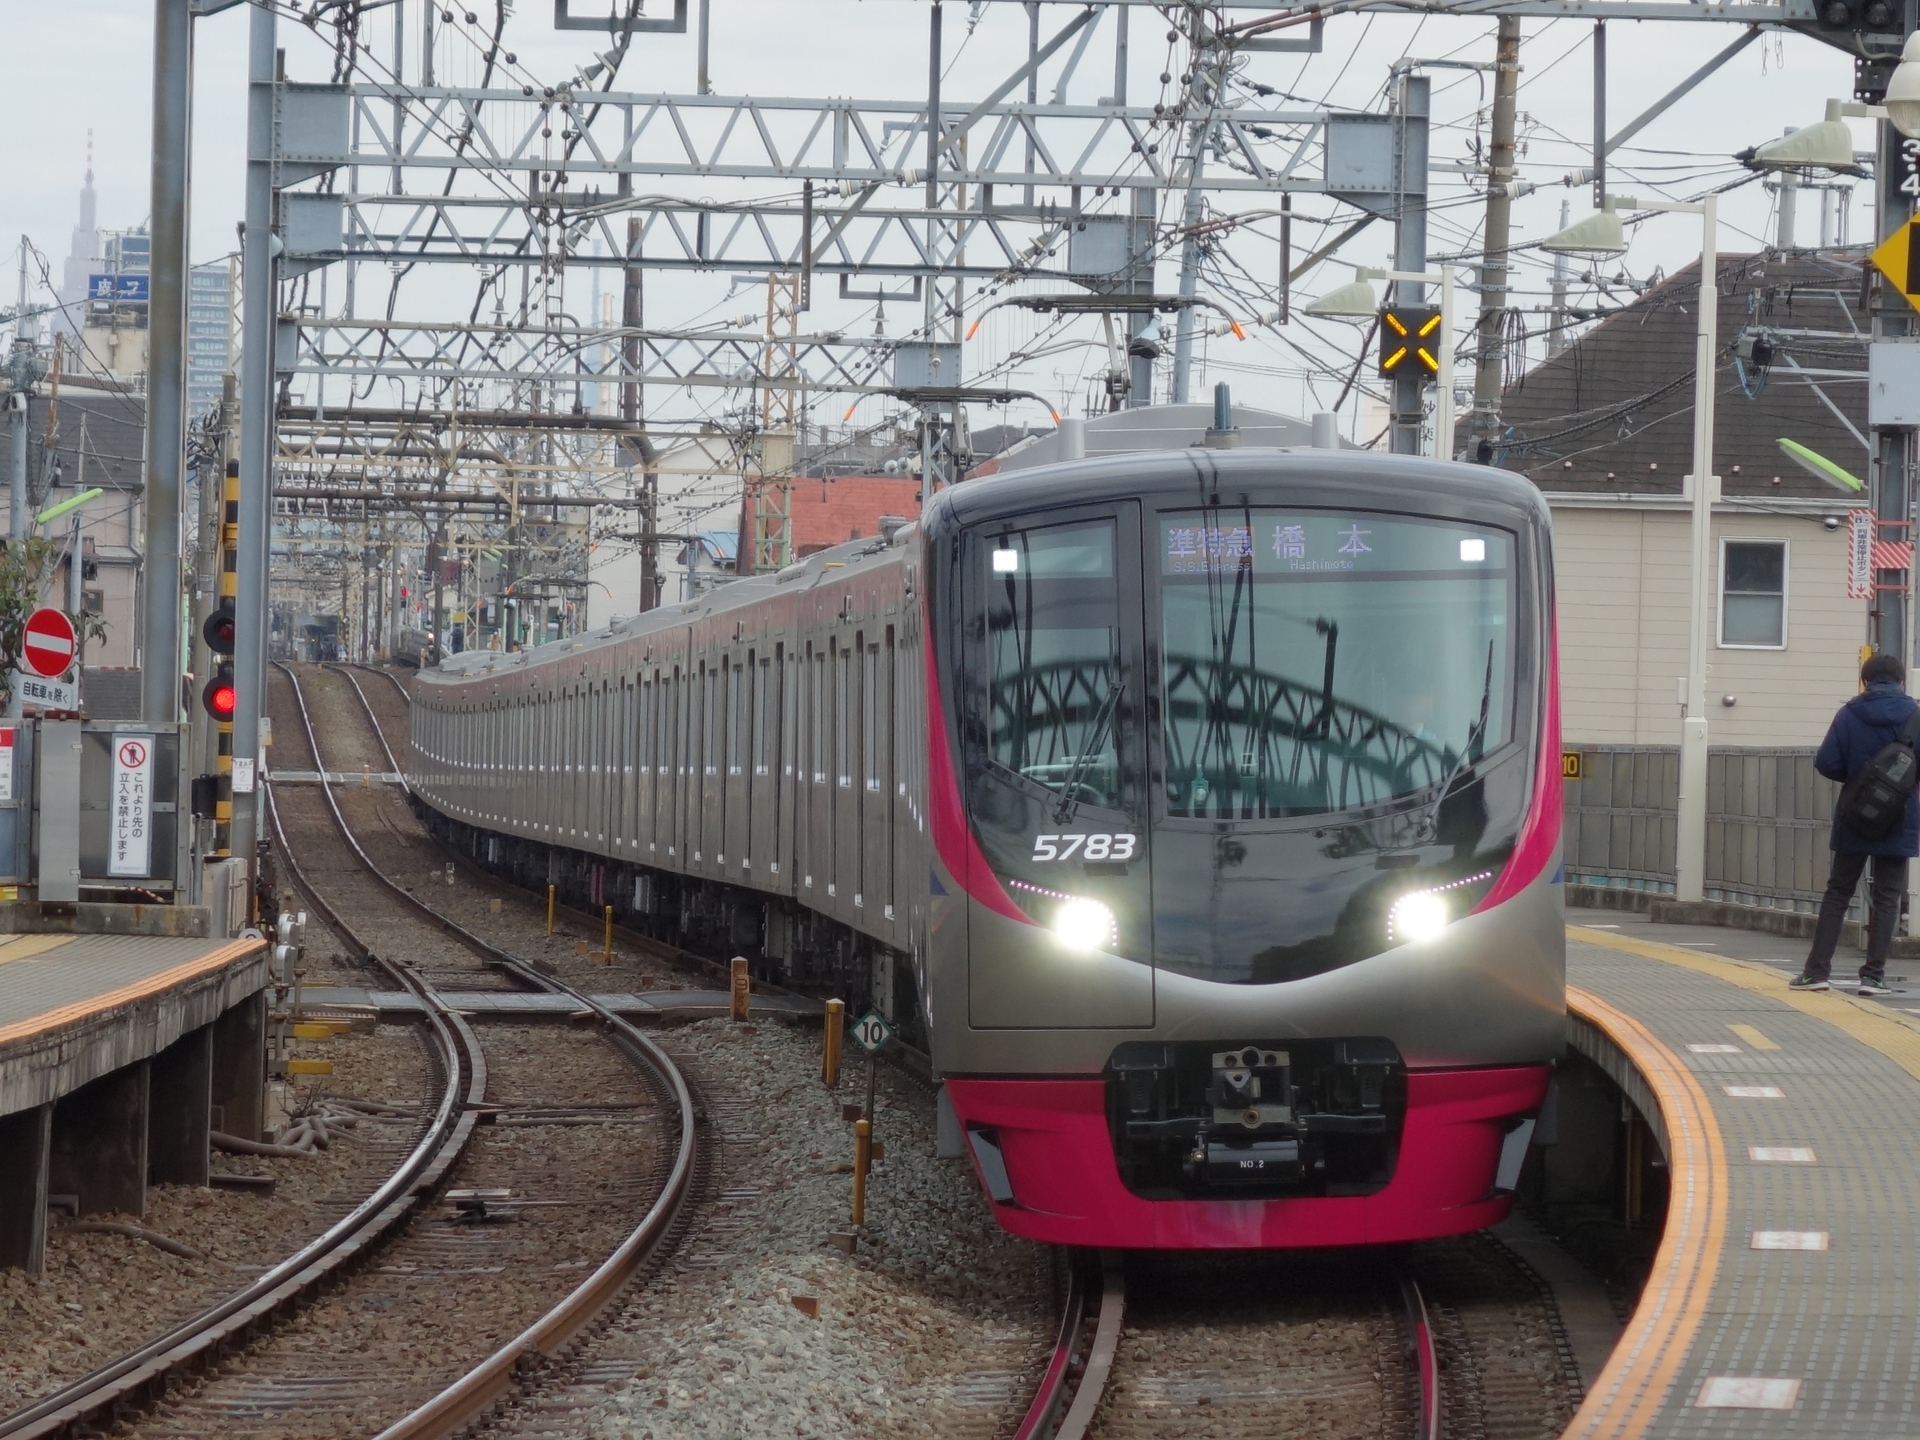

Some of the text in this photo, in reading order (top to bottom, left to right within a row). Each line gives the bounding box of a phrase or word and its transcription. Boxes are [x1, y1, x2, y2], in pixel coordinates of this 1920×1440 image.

[1168, 524, 1373, 560] 準特急 橋本
[1857, 528, 1868, 577] 列車非常停止ボタン
[1290, 559, 1355, 571] Hashimoto
[23, 680, 69, 704] 自転車を除く
[1562, 755, 1578, 775] 10
[117, 772, 130, 861] 立入を禁止します
[131, 772, 144, 838] これより先の
[1032, 833, 1136, 861] 5783
[862, 1021, 883, 1044] 10
